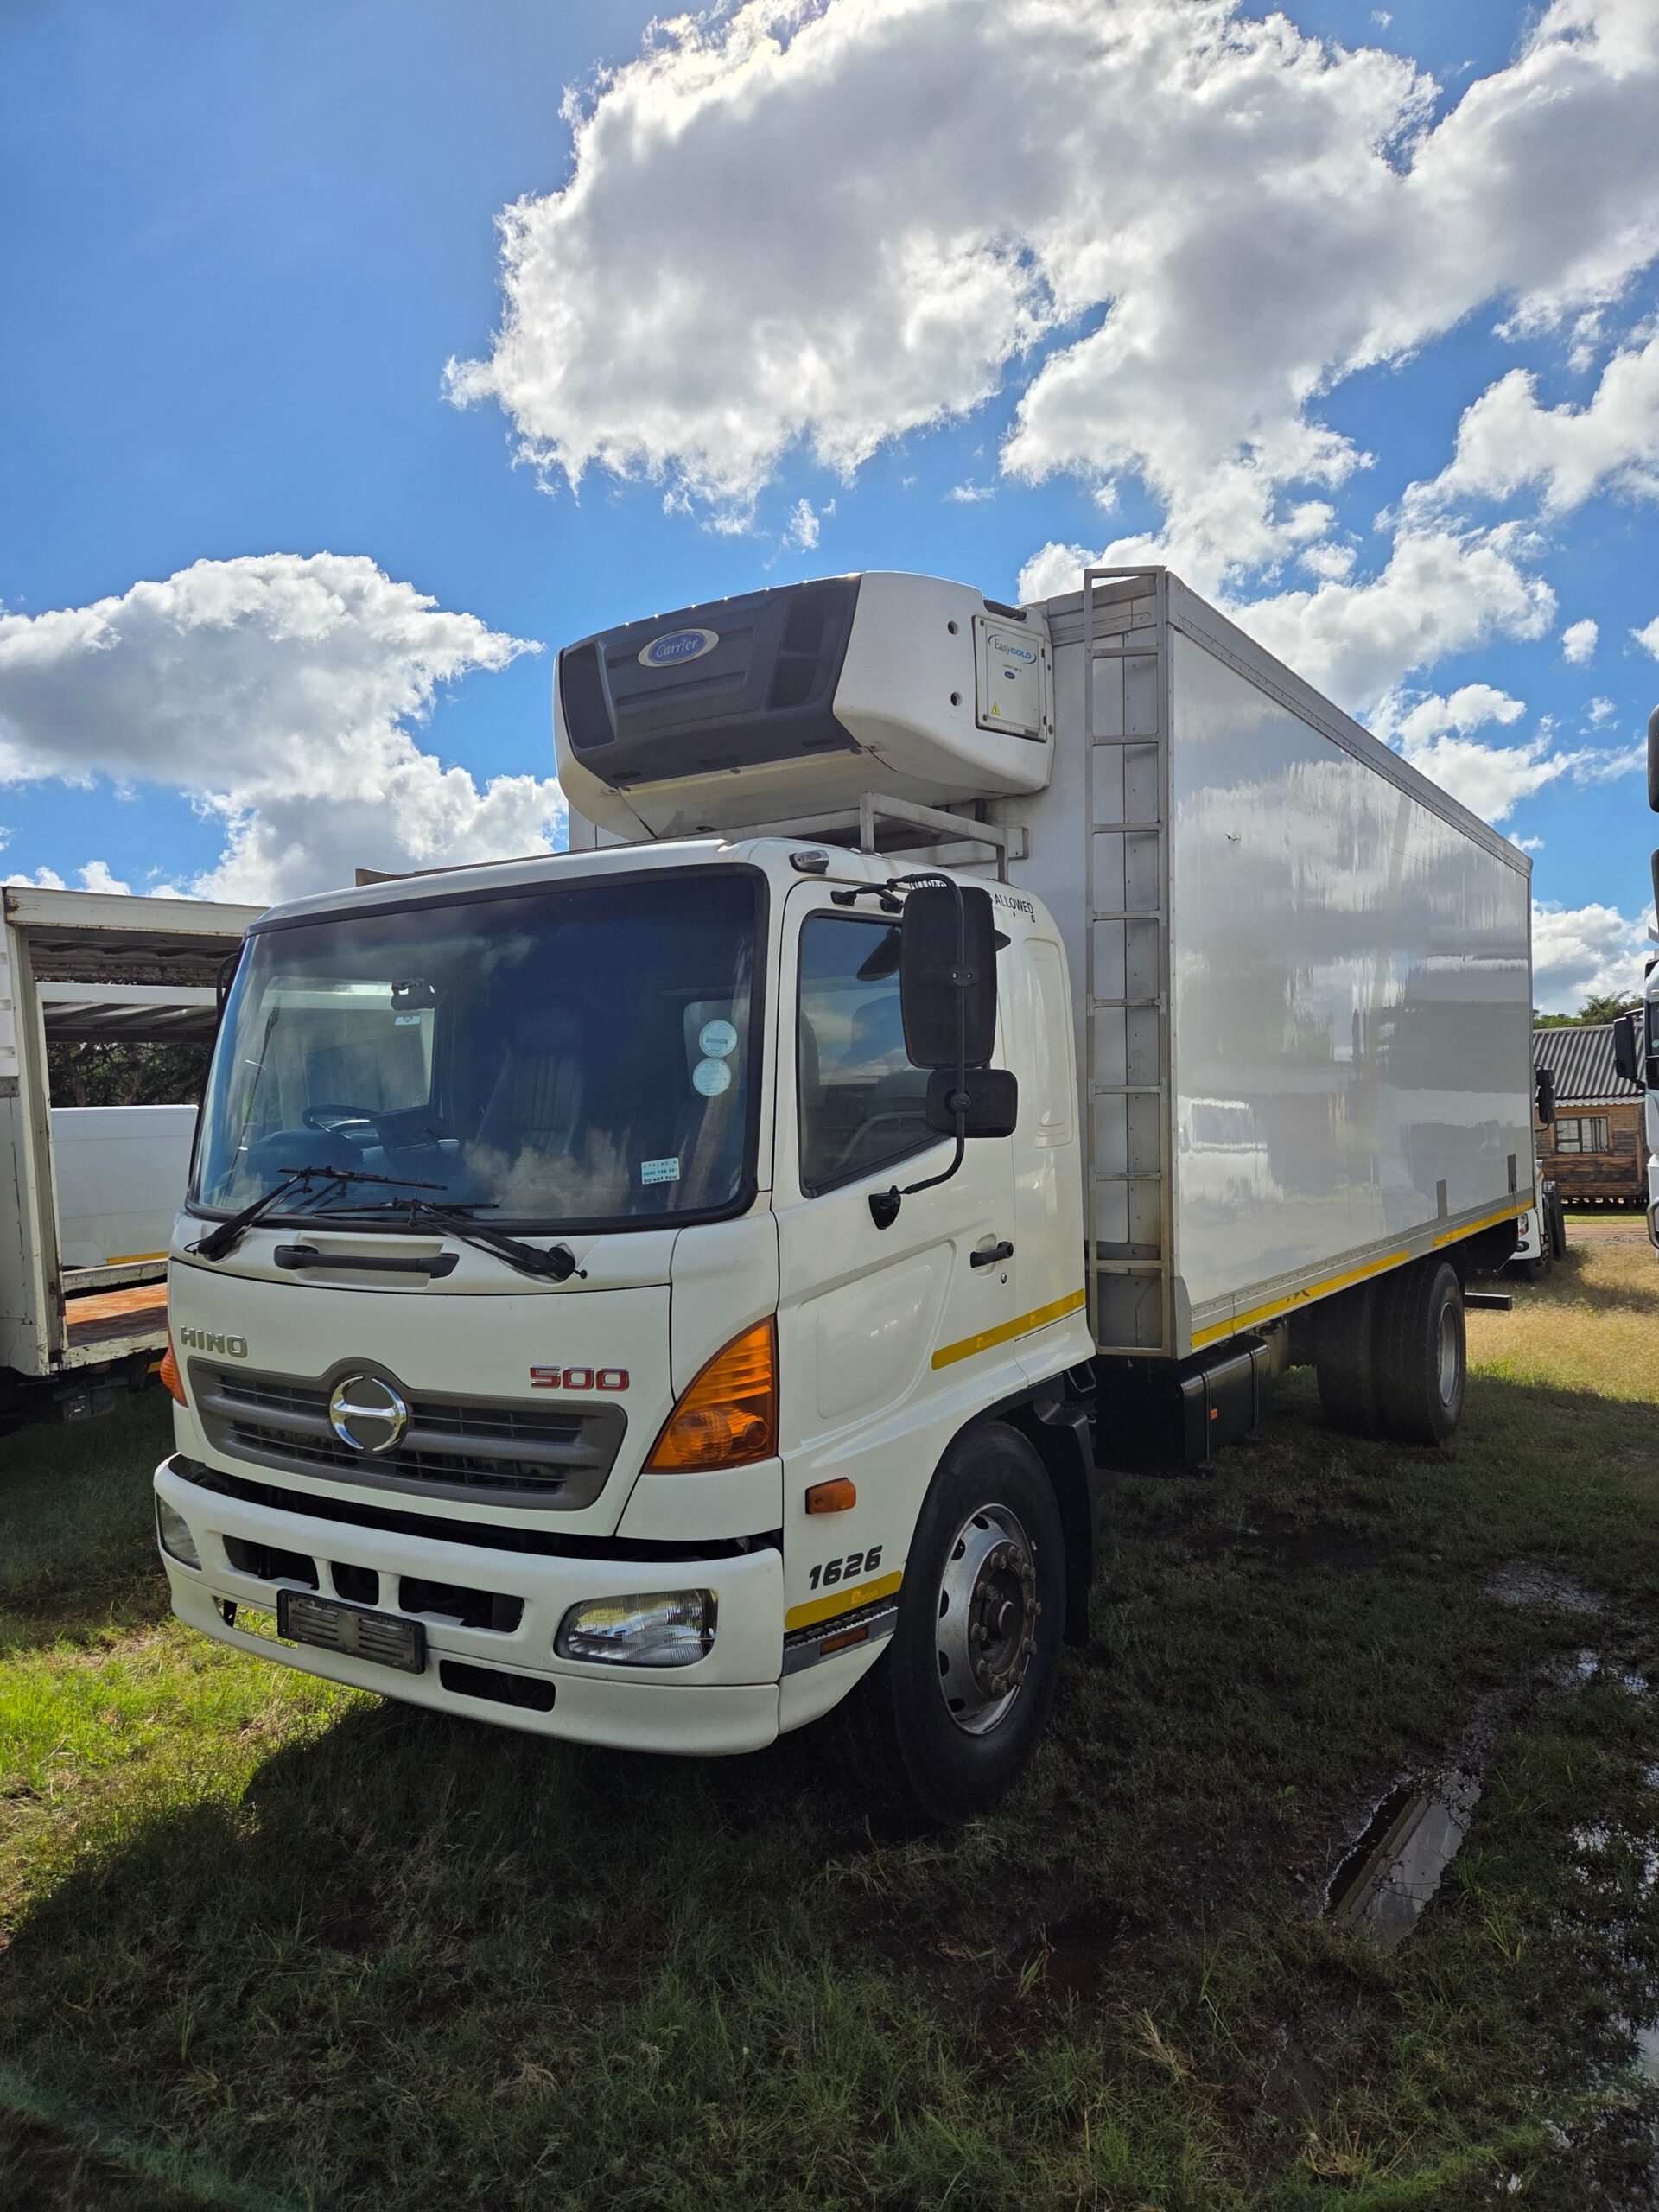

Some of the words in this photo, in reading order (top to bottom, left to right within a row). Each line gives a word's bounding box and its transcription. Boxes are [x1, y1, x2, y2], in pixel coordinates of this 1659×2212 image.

[656, 639, 698, 658] Carrier
[994, 638, 1033, 659] EasyCOLD
[995, 893, 1034, 914] ALLOWED
[181, 1325, 248, 1358] HINO
[530, 1364, 630, 1392] 500
[809, 1545, 883, 1591] 1626
